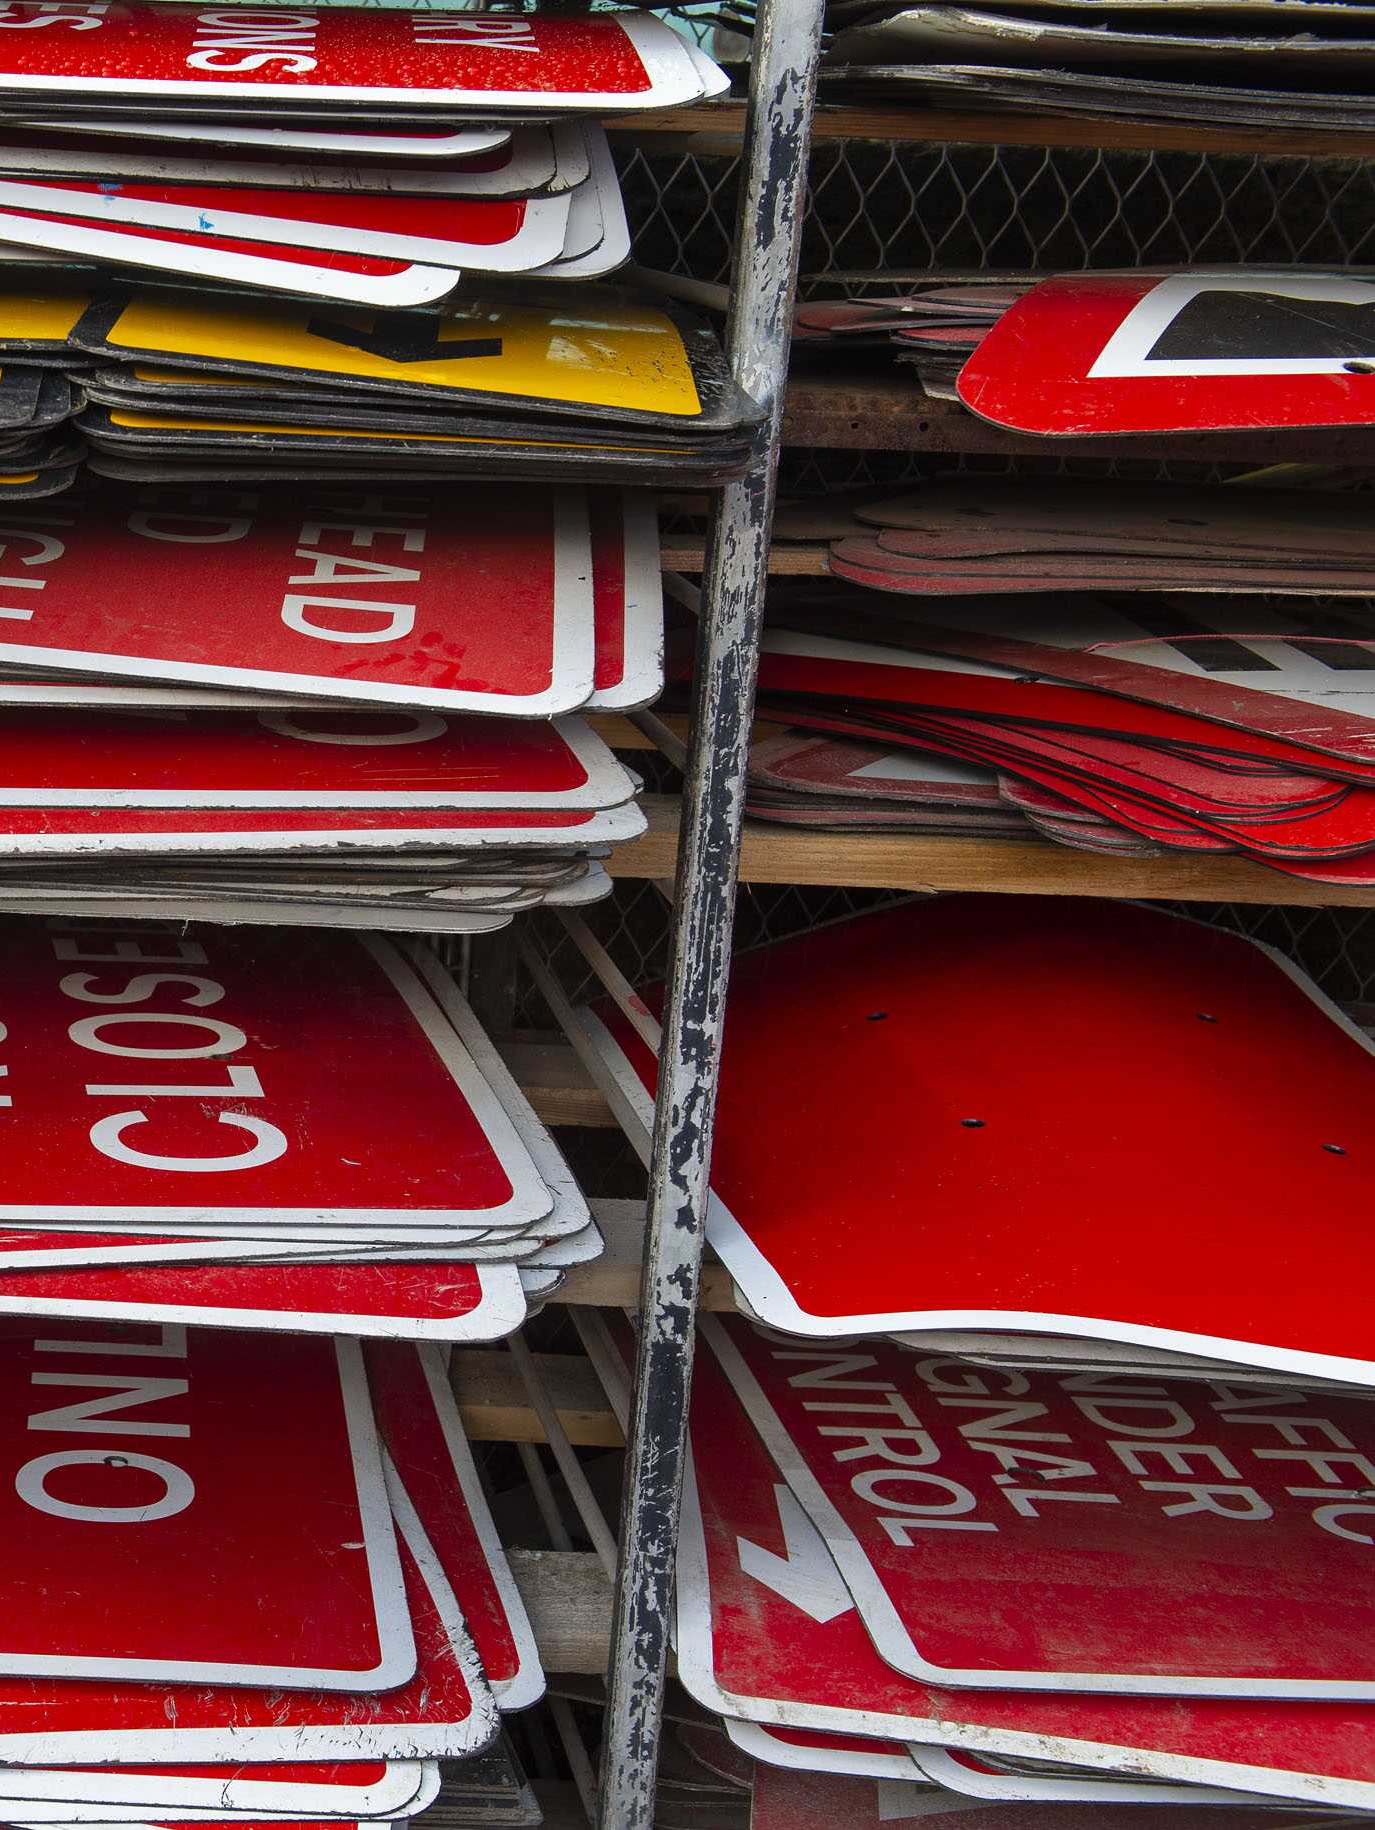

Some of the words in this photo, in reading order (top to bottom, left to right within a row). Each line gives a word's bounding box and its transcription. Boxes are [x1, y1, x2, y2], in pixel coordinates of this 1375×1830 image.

[186, 7, 321, 75] IONS
[280, 488, 431, 644] HEAD
[14, 1325, 196, 1523] ONL
[910, 1354, 1122, 1518] GNAL
